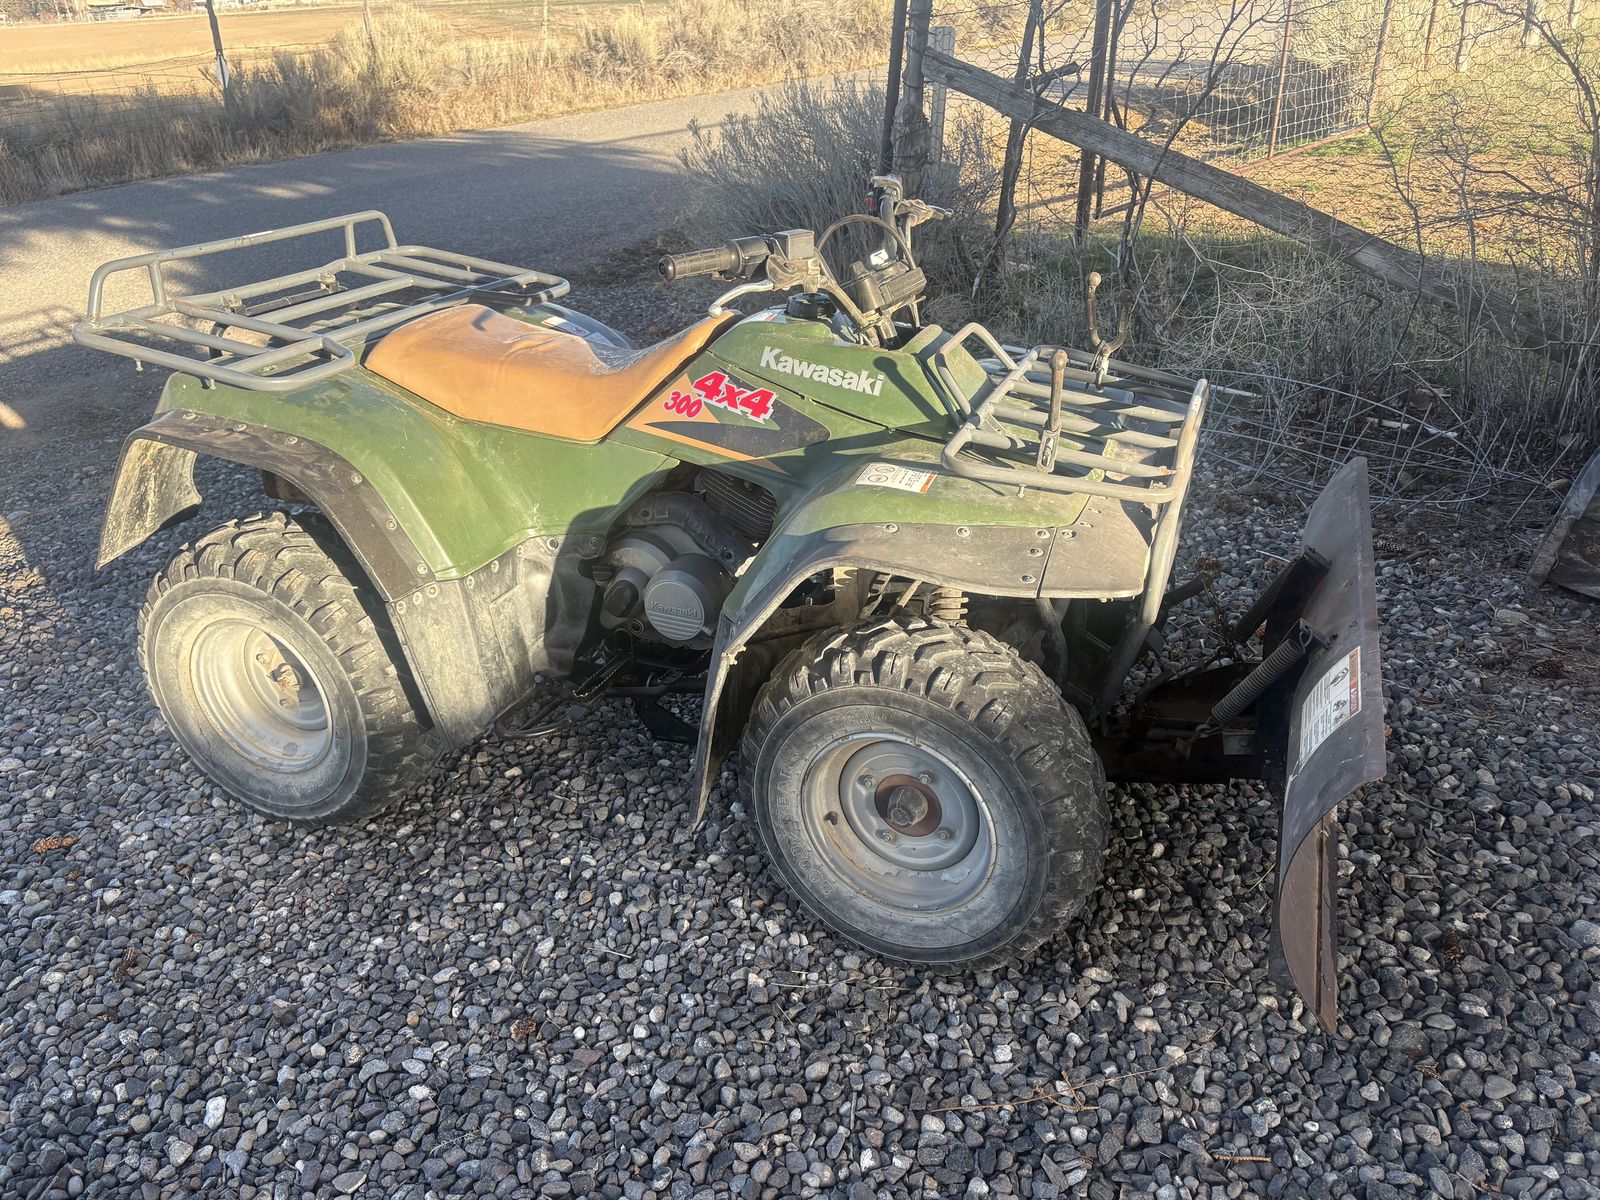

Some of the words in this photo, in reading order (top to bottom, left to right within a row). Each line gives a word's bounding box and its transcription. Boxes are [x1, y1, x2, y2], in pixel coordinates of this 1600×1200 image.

[760, 346, 885, 397] Kawasaki
[664, 391, 704, 419] 300
[692, 370, 779, 424] 4x4
[650, 600, 698, 617] Kawasaki
